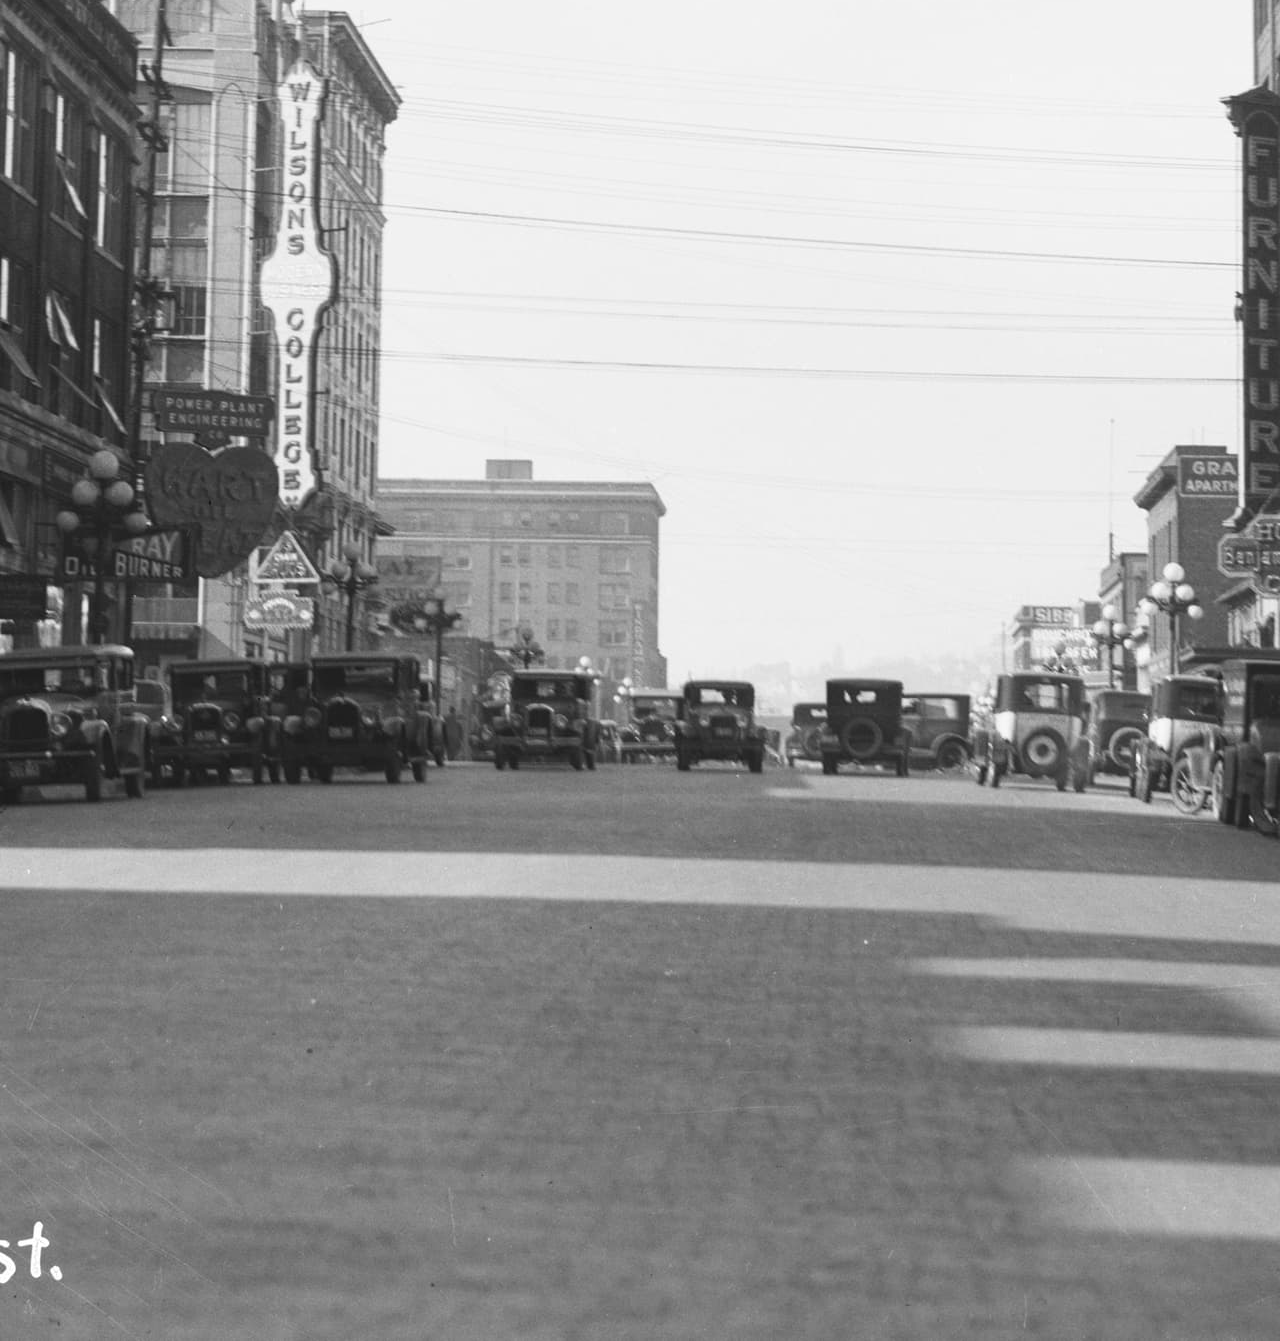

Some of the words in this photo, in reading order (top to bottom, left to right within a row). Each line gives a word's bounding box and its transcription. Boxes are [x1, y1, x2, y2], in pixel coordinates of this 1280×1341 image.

[1246, 136, 1280, 495] FURNITURE
[165, 396, 213, 411] POWER
[218, 400, 265, 415] PLANT
[281, 308, 306, 493] COLLEGE
[168, 412, 263, 429] ENGINEERING
[130, 530, 180, 563] RAY
[114, 551, 185, 579] BURNER
